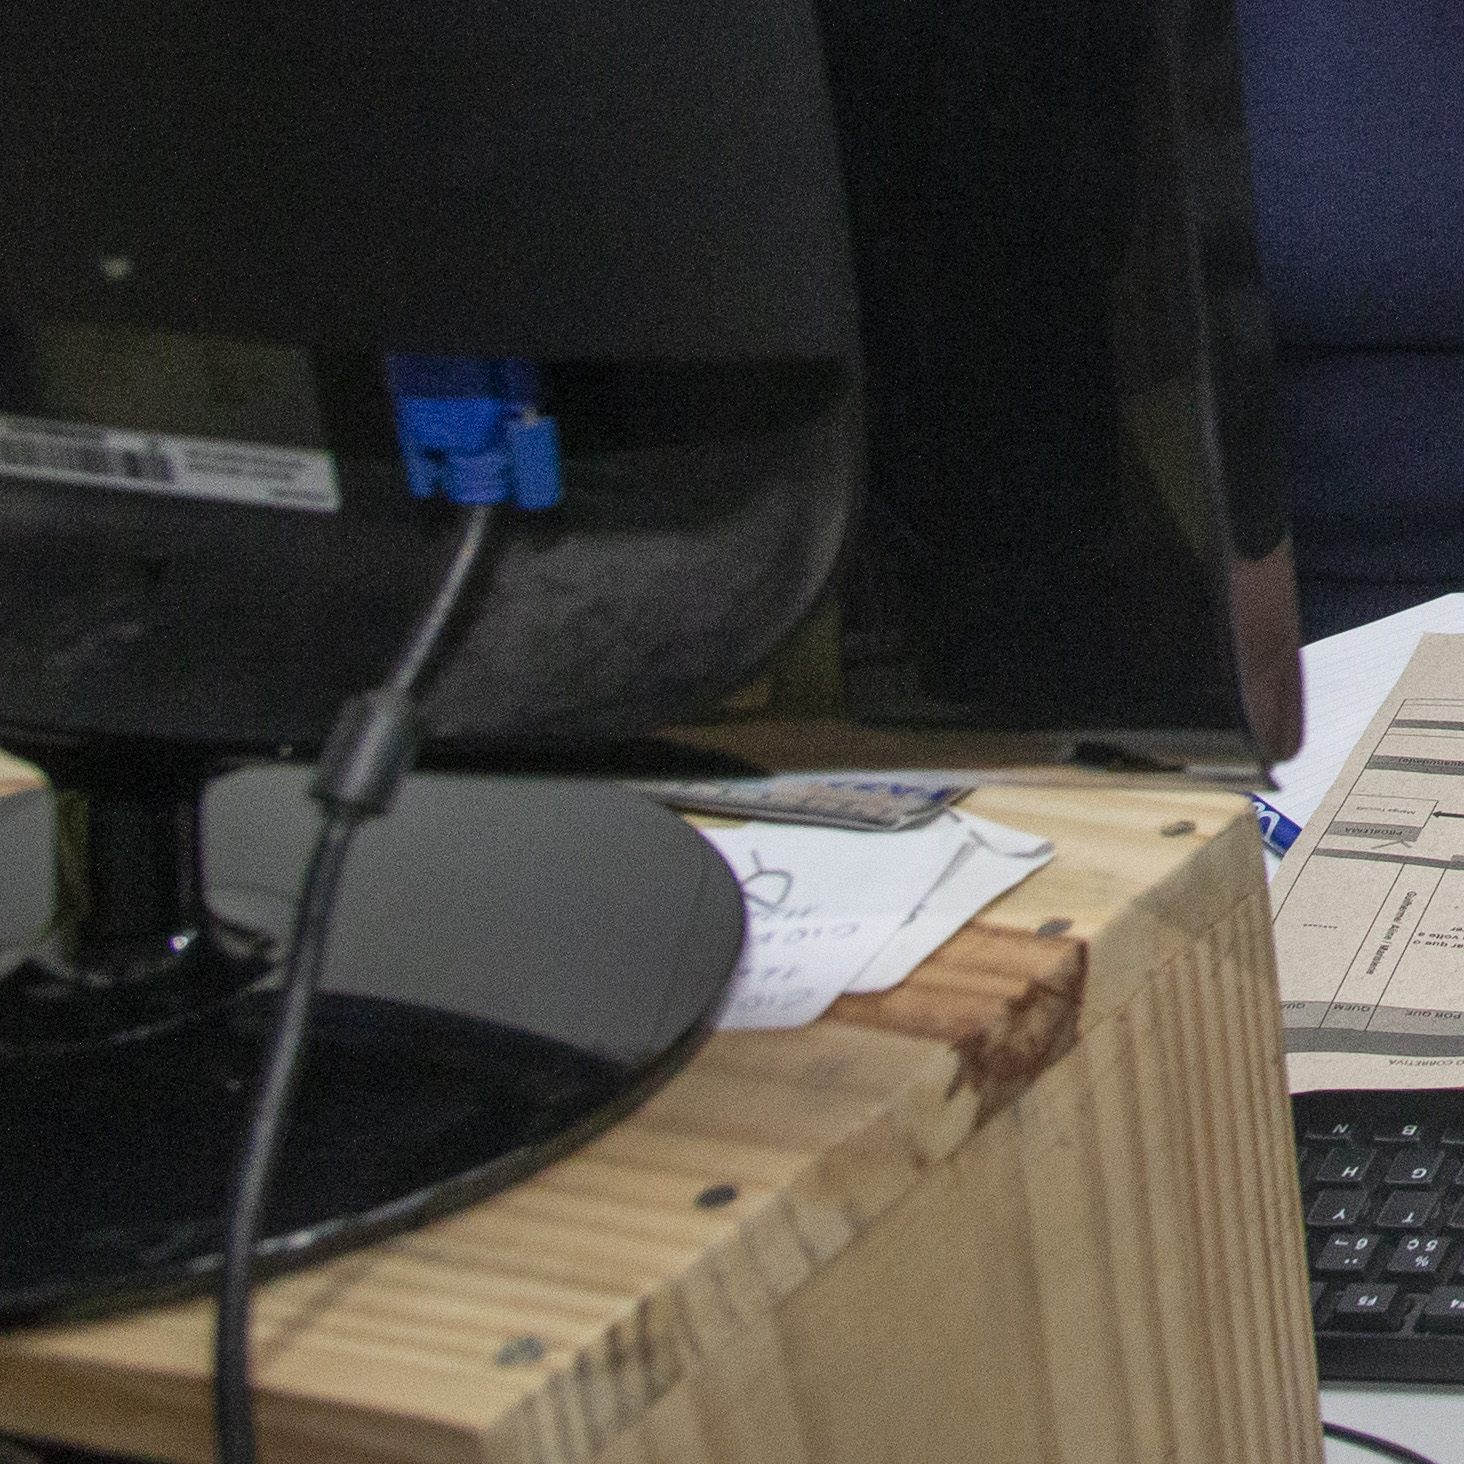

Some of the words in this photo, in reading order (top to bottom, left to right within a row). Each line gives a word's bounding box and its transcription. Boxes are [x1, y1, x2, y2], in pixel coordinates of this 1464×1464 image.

[1344, 827, 1402, 836] PROBLEMA
[1332, 1004, 1370, 1012] QUEM
[1332, 1124, 1349, 1134] N
[1401, 1124, 1418, 1135] B
[1341, 1166, 1359, 1177] H
[1411, 1168, 1427, 1179] G
[1331, 1208, 1346, 1220] Y
[1401, 1212, 1414, 1223] T
[1357, 1295, 1378, 1306] F5
